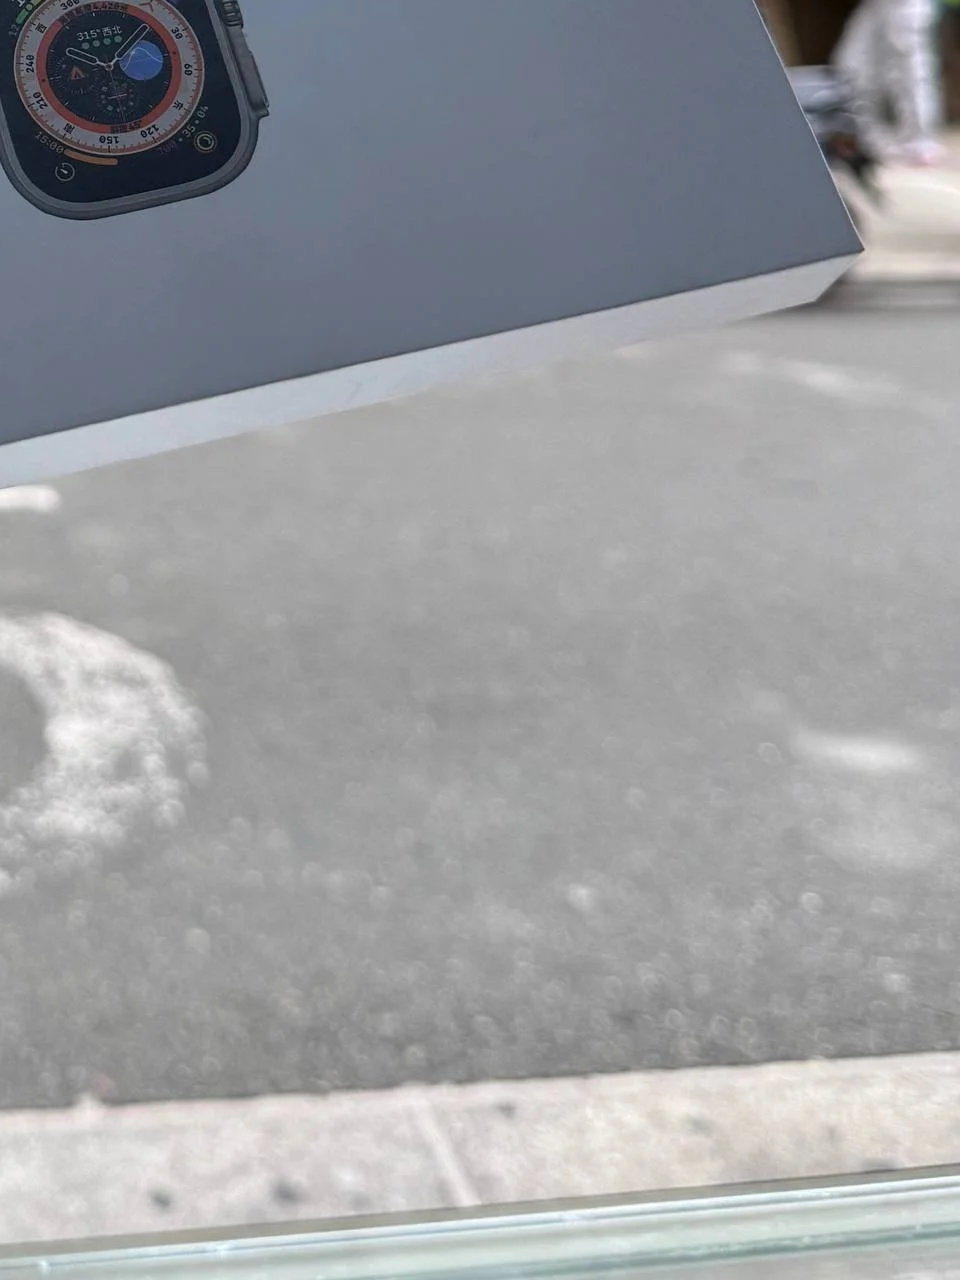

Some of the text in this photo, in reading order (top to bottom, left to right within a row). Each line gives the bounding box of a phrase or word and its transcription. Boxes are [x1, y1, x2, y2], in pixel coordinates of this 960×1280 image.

[171, 26, 184, 40] 30
[25, 54, 35, 73] 240
[183, 63, 193, 76] 60
[32, 91, 48, 110] 210
[140, 124, 159, 138] 120
[98, 135, 120, 144] 150
